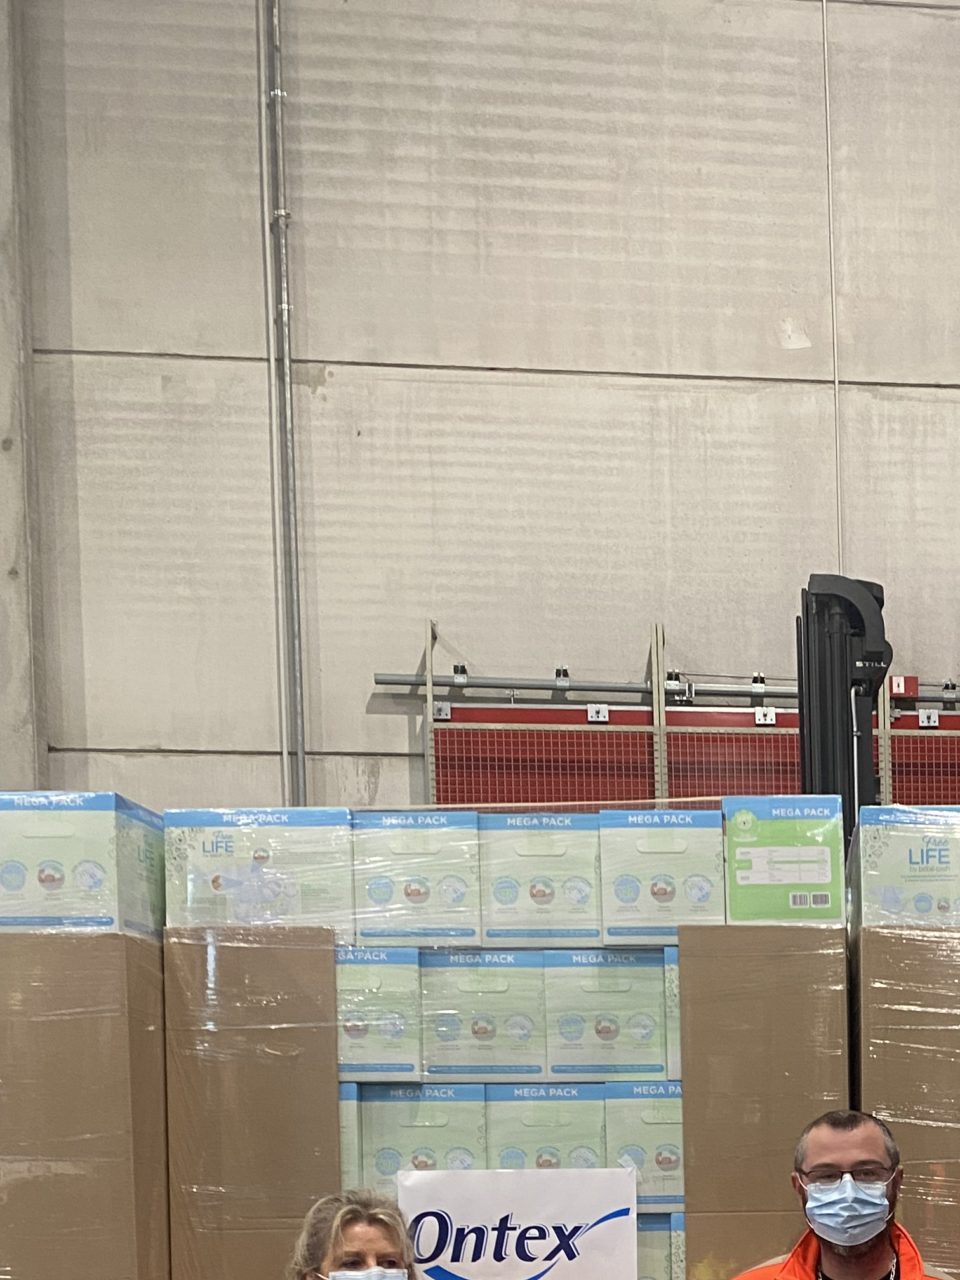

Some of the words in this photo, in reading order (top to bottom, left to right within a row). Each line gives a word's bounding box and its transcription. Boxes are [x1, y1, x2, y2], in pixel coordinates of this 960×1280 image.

[772, 808, 801, 817] MEGA
[804, 807, 831, 817] PACK
[260, 814, 289, 823] PACK
[382, 815, 414, 825] MEGA
[417, 815, 447, 825] PACK
[507, 817, 539, 826] MEGA
[542, 817, 571, 826] PACK
[628, 815, 660, 825] MEGA
[663, 815, 693, 824] PACK
[202, 840, 235, 853] LIFE
[908, 848, 951, 865] LIFE
[357, 952, 388, 960] PACK
[450, 954, 482, 963] MEGA
[485, 954, 514, 963] PACK
[572, 954, 604, 963] MEGA
[608, 954, 636, 963] PACK
[390, 1088, 422, 1097] MEGA
[426, 1088, 455, 1097] PACK
[514, 1088, 546, 1097] MEGA
[549, 1088, 578, 1097] PACK
[633, 1086, 666, 1095] MEGA
[409, 1209, 588, 1264] Ontex
